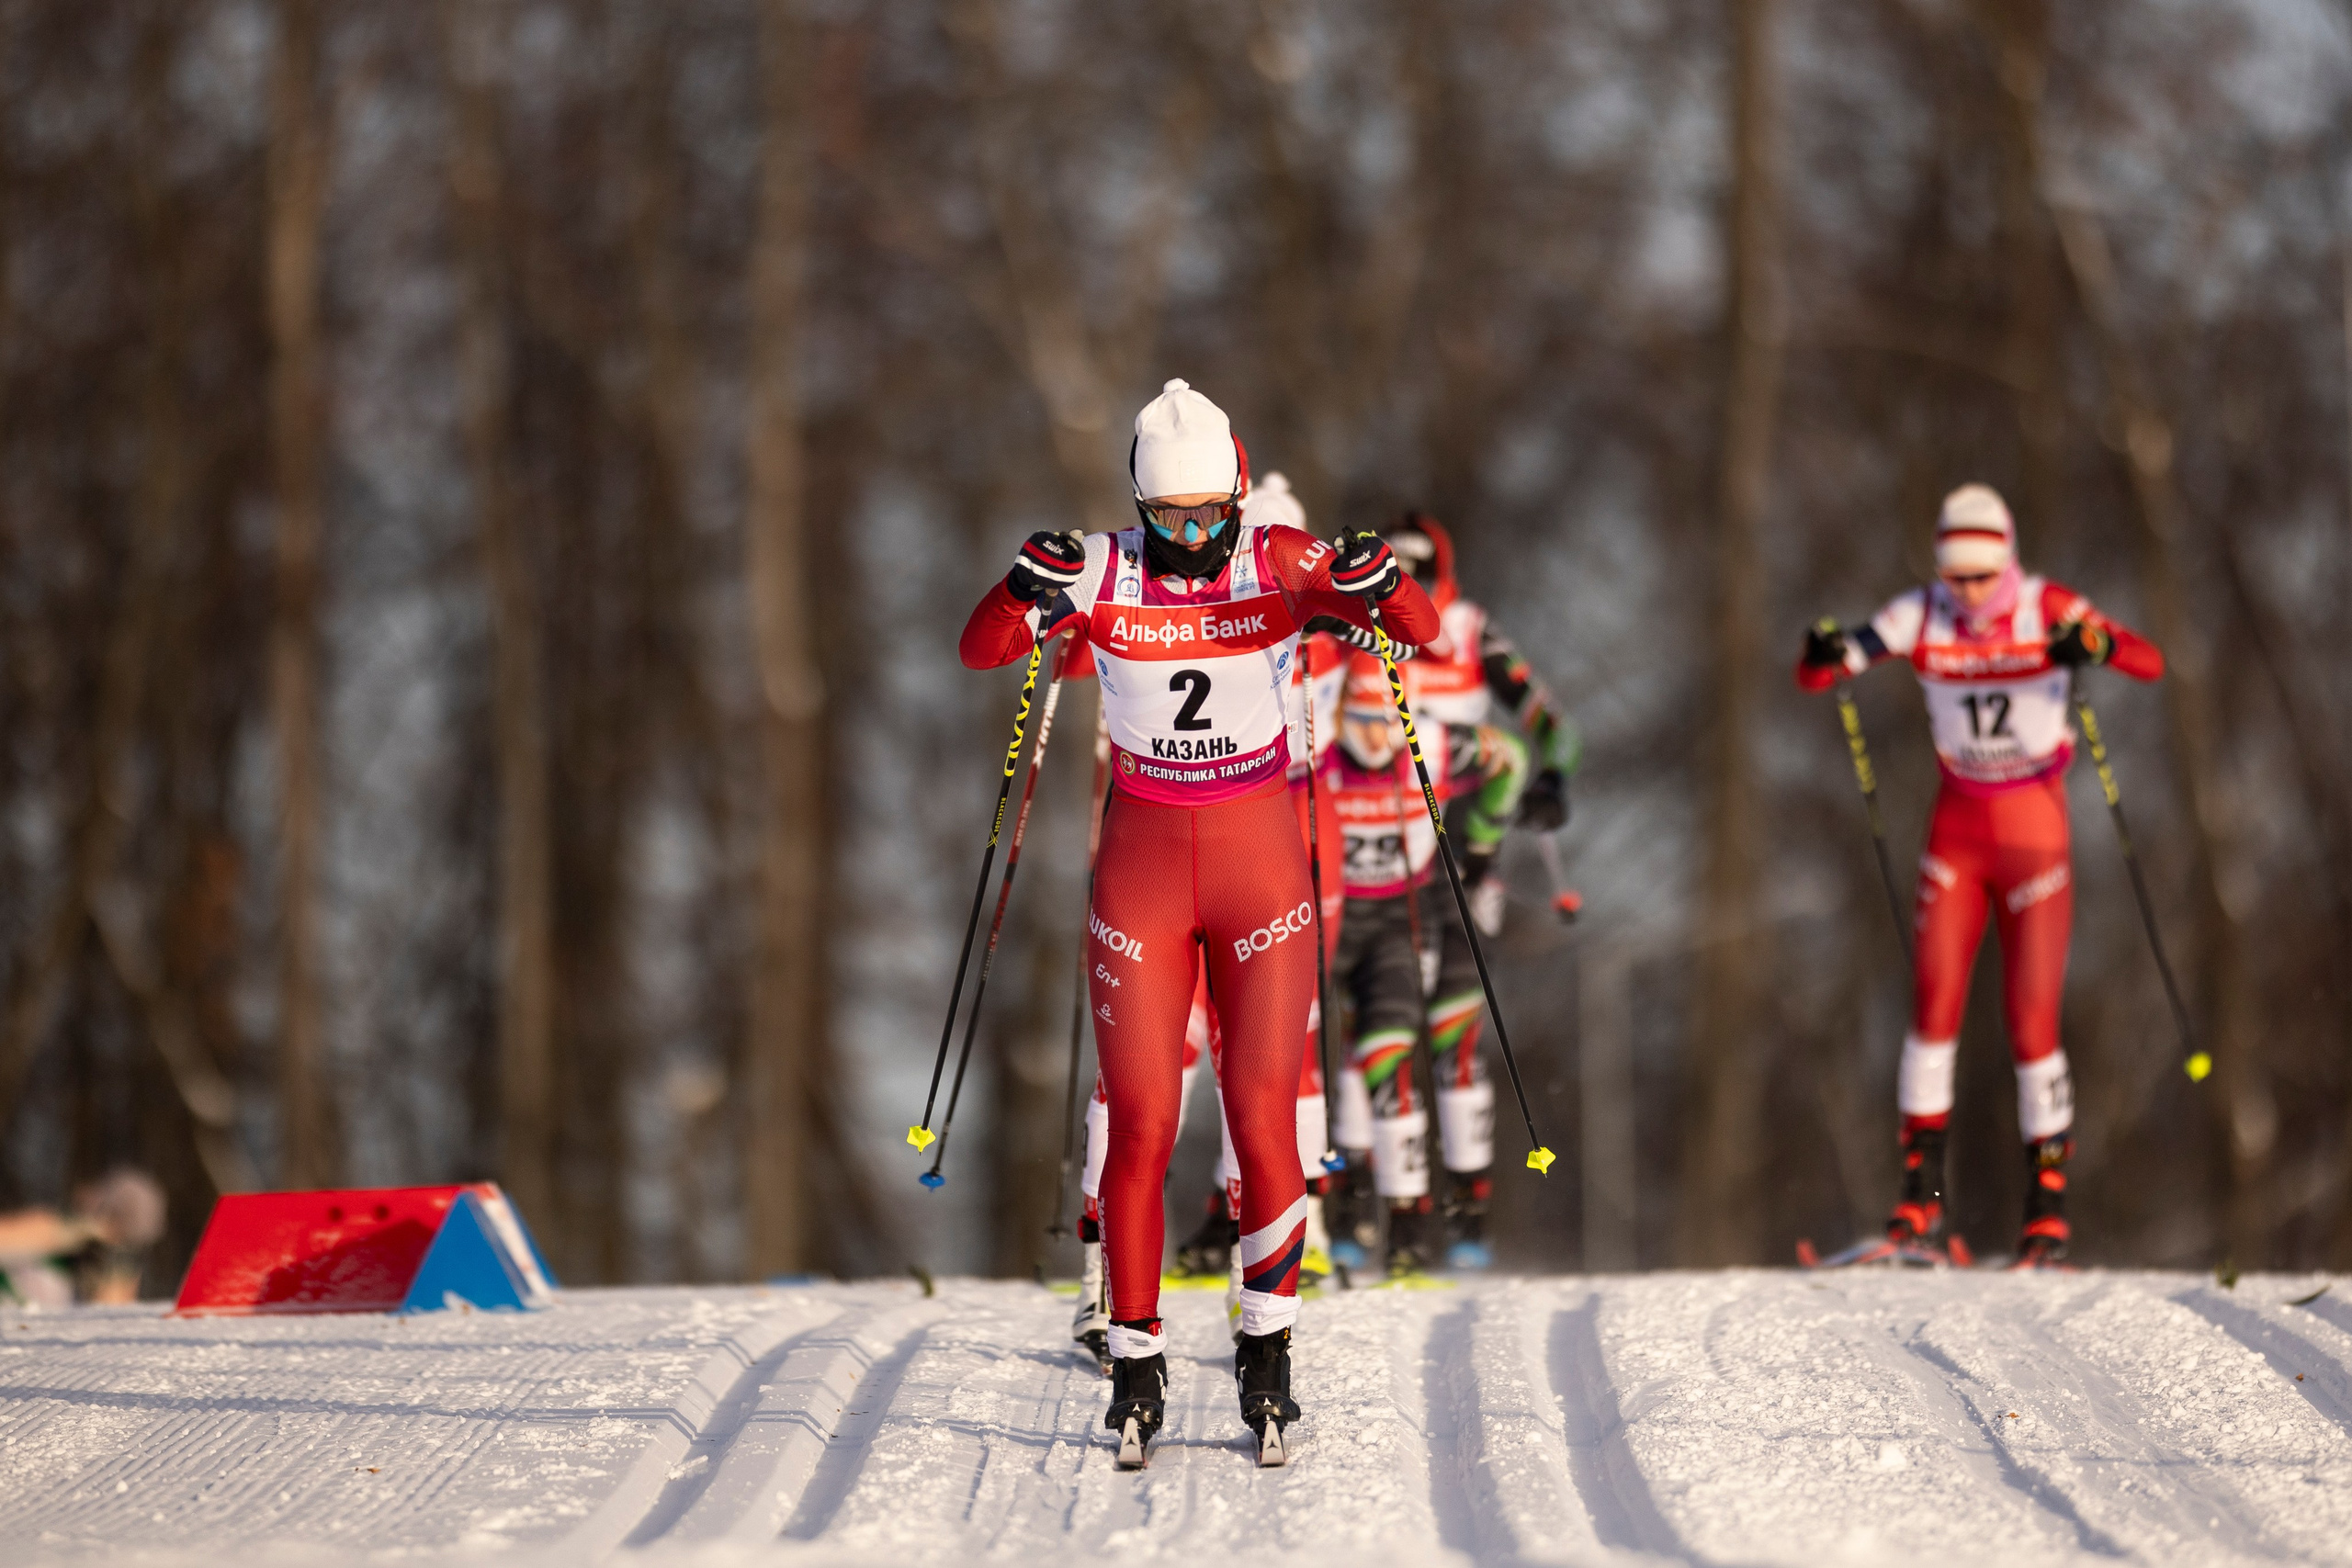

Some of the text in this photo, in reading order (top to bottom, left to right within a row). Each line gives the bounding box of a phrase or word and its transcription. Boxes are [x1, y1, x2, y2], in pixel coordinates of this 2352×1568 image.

[1110, 613, 1268, 649] Альфа Банк
[1169, 669, 1212, 731] 2
[1962, 692, 2014, 739] 12
[1151, 736, 1238, 760] КАЗАНЬ
[1140, 763, 1216, 782] РЕСПУБЛИКА
[994, 796, 1007, 832] BLACKCODE
[1424, 783, 1440, 820] BLACKCODE
[1233, 901, 1312, 963] BOSCO
